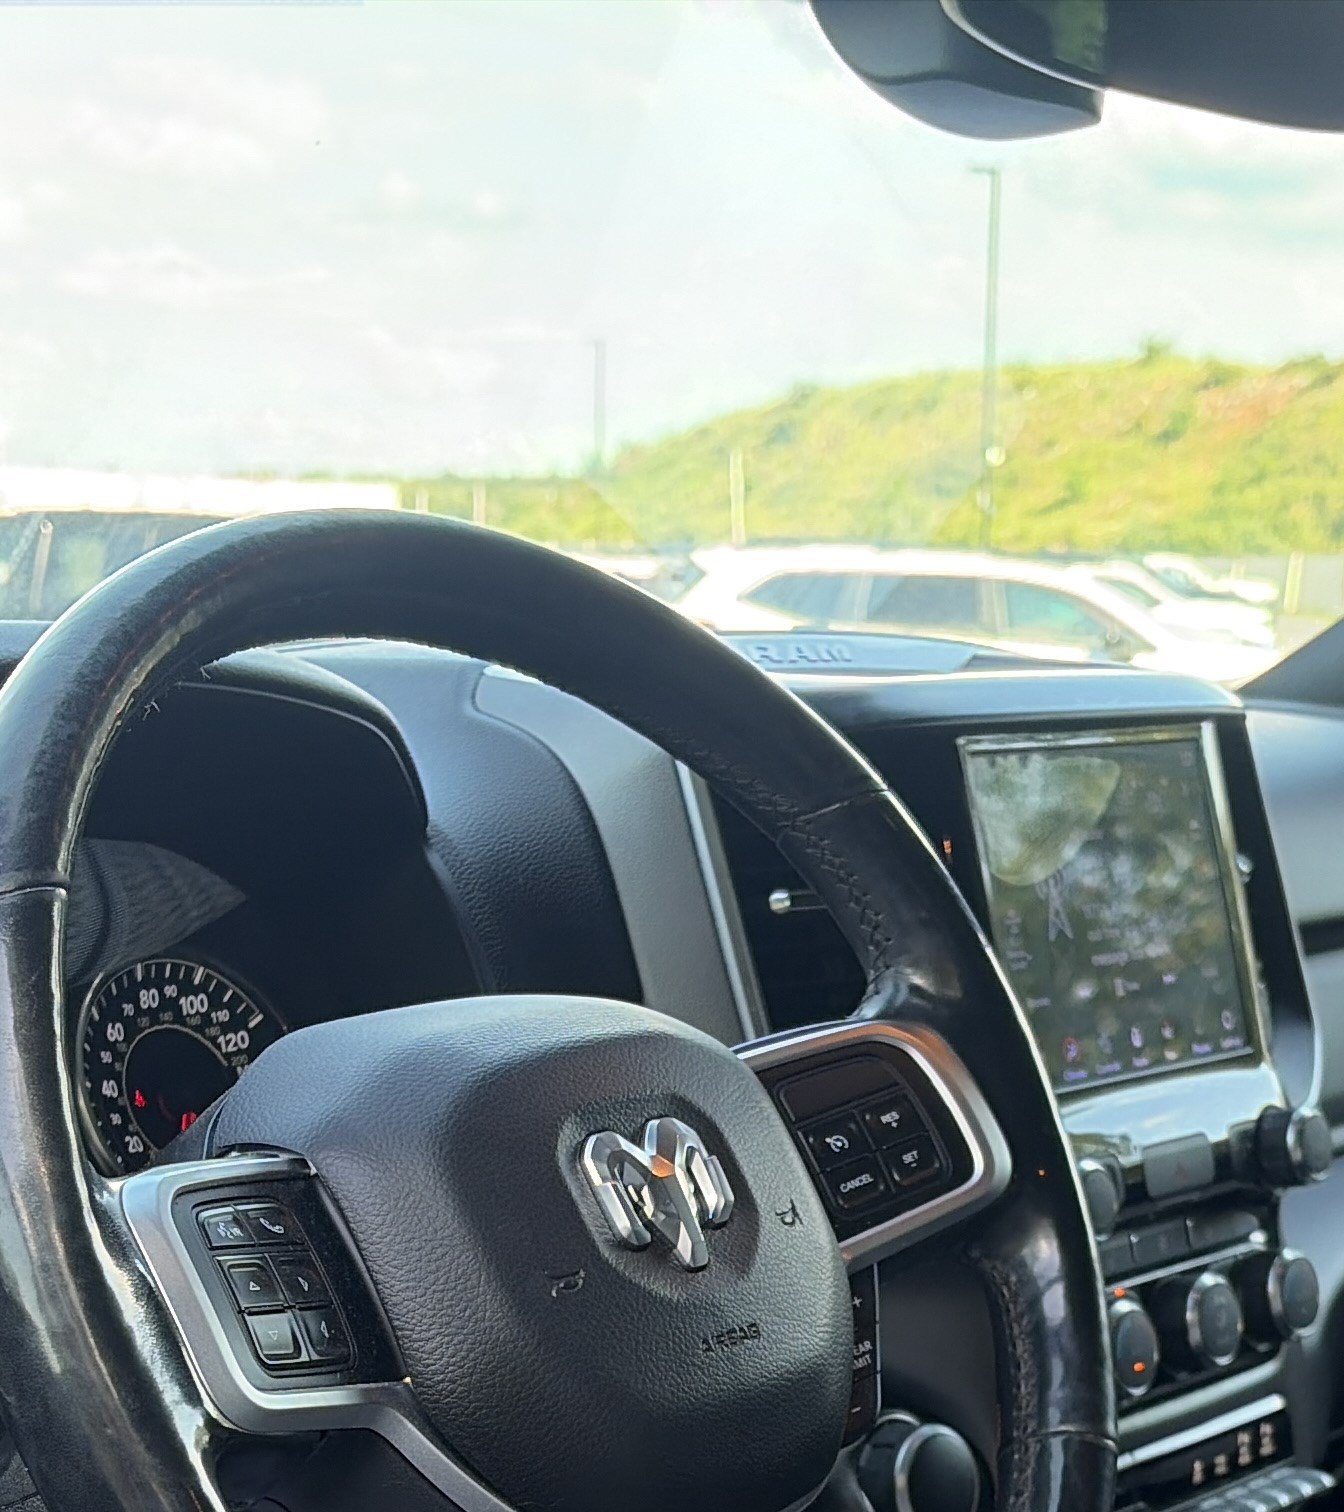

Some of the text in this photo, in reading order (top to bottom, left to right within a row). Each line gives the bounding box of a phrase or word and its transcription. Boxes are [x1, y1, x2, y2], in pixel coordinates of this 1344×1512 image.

[752, 644, 853, 664] RAM
[139, 988, 159, 1009] 80
[163, 984, 178, 998] 90
[122, 1003, 135, 1017] 70
[179, 993, 208, 1016] 100
[211, 1009, 230, 1024] 110
[106, 1022, 125, 1042] 60
[216, 1030, 250, 1053] 120
[101, 1080, 119, 1098] 40
[880, 1111, 900, 1124] RES
[124, 1135, 144, 1153] 20
[902, 1150, 918, 1164] SET
[839, 1173, 875, 1193] CANCEL
[853, 1340, 873, 1355] EAR
[853, 1354, 872, 1369] MIT
